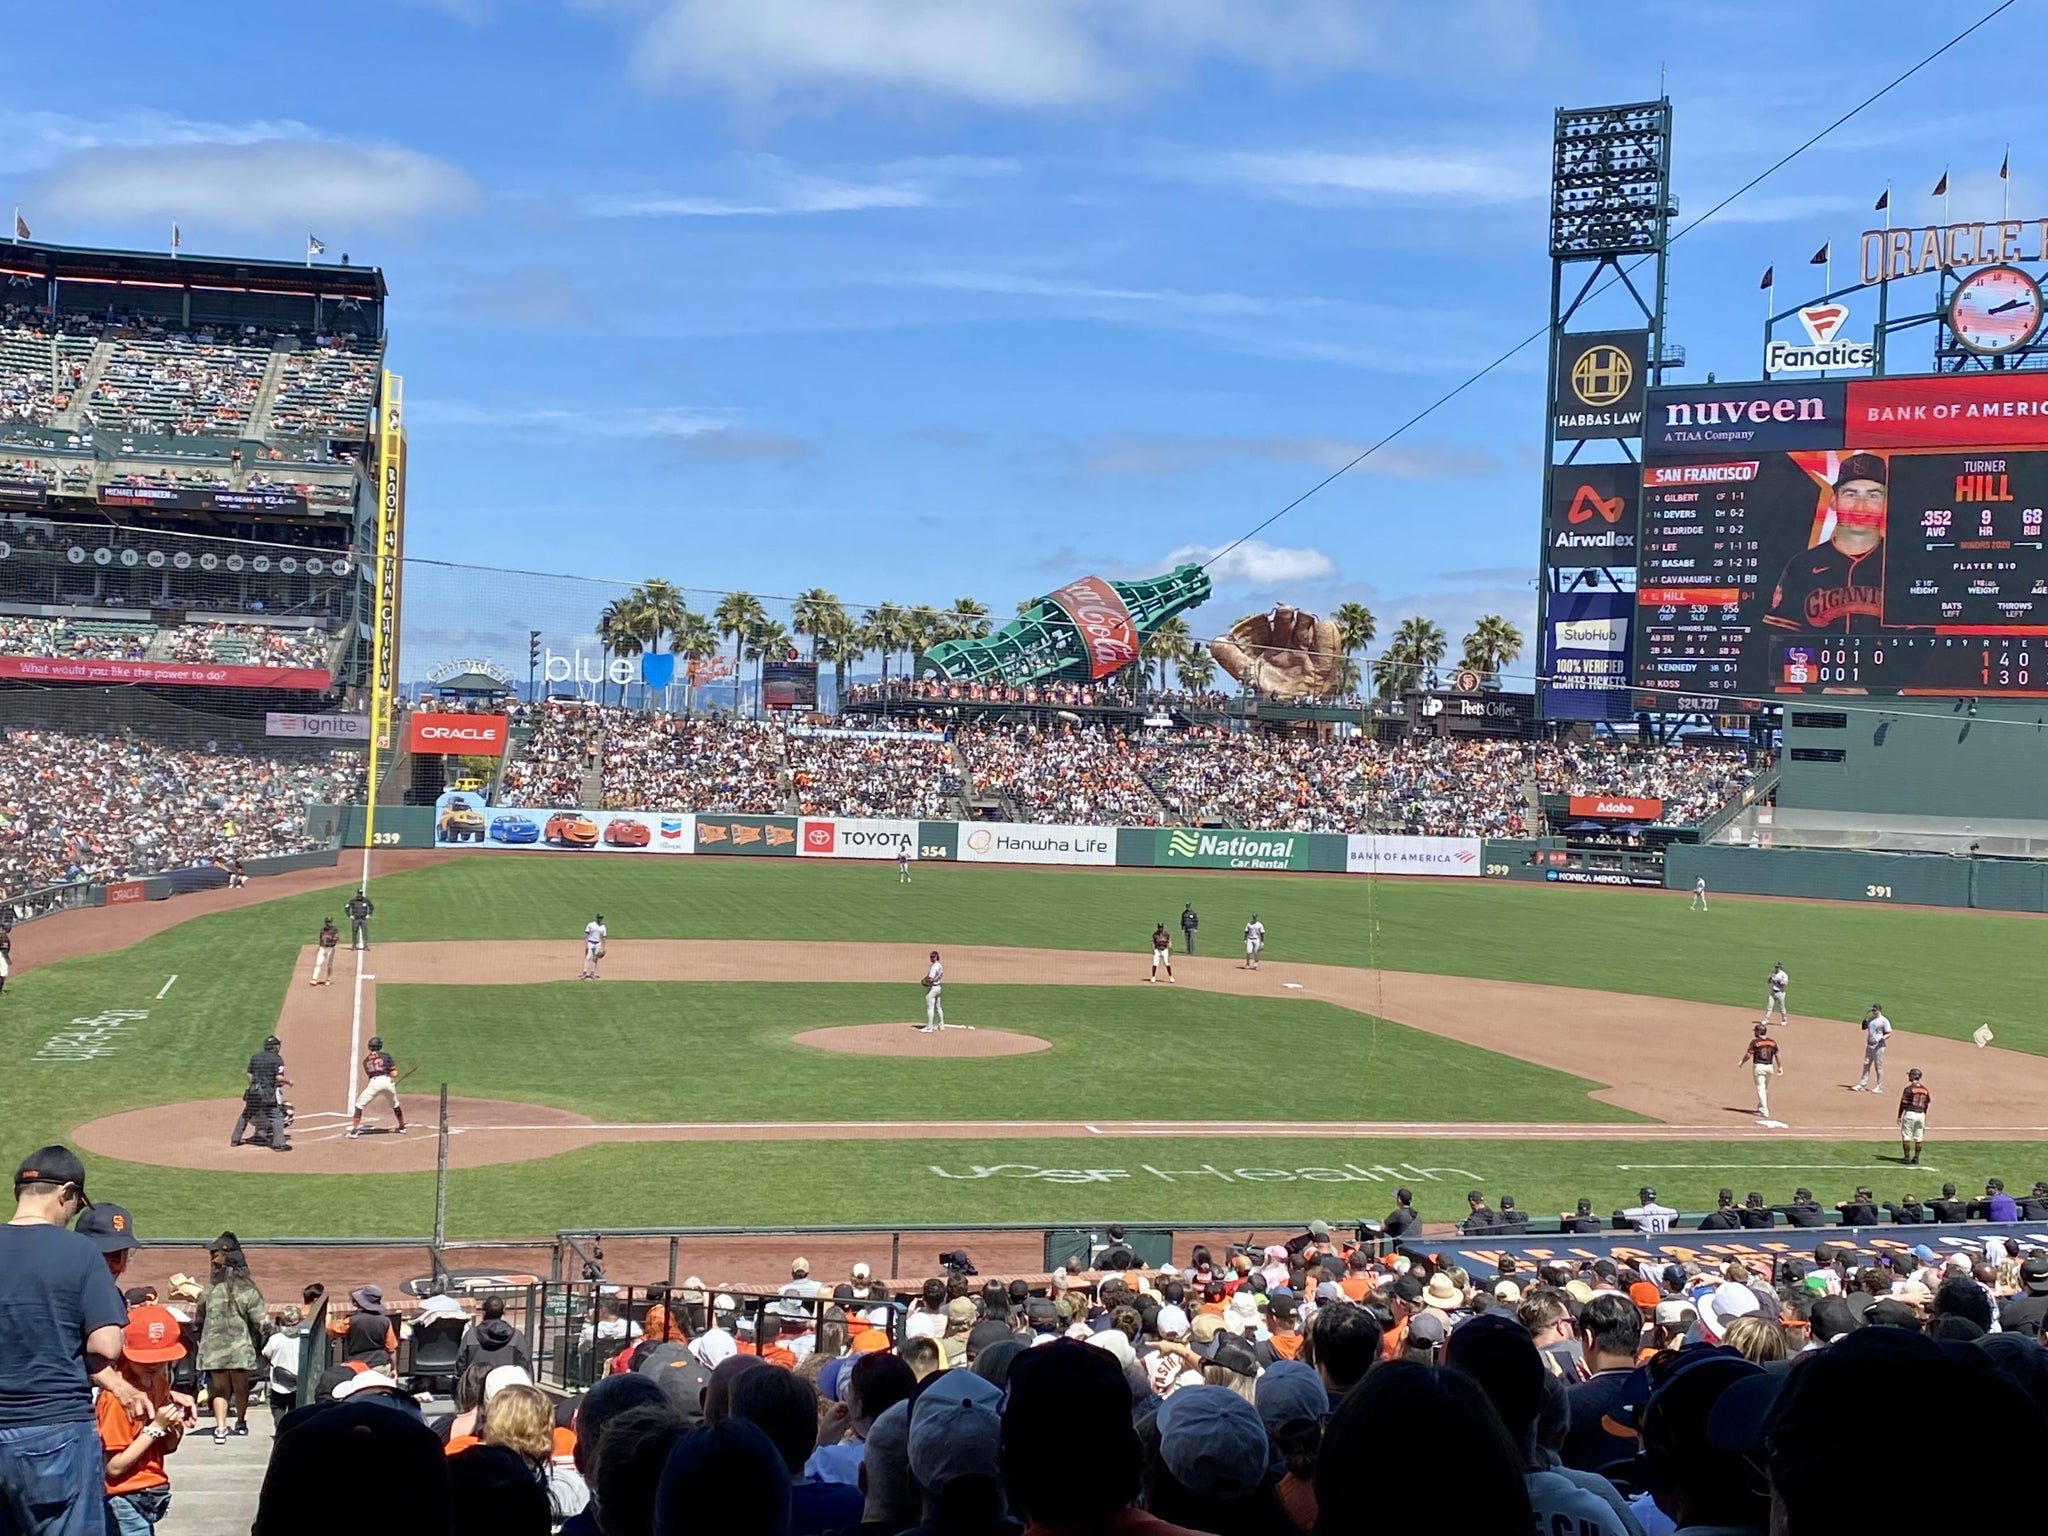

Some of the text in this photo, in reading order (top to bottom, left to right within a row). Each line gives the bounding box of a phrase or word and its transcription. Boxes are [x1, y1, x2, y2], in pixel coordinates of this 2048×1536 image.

[1860, 220, 2022, 286] ORACLE
[1993, 273, 2001, 281] 12
[1770, 343, 1873, 367] Fanatics
[1665, 396, 1825, 427] nuveen
[1867, 406, 1926, 421] BANK
[1933, 404, 1961, 419] OF
[1559, 412, 1641, 427] HABBAS LAW
[1664, 431, 1755, 442] A TIAA Company
[1964, 460, 2006, 473] TURNER
[1656, 467, 1751, 482] SAN FRANCISCO
[105, 488, 134, 496] MICHAEL
[135, 490, 171, 498] LORENZEN
[1956, 475, 2014, 502] HILL
[215, 495, 252, 503] FOUR-SEAM
[264, 496, 284, 504] 92.4
[1664, 493, 1699, 502] GILBERT
[1731, 492, 1744, 500] 1-1
[1664, 510, 1696, 518] DEVERS
[1730, 509, 1744, 517] 0-2
[1921, 510, 1952, 526] .352
[1981, 510, 1992, 525] 9
[2022, 509, 2043, 524] 68
[1663, 526, 1704, 534] ELDRIDGE
[1729, 525, 1744, 534] 0-2
[1926, 527, 1945, 537] AVG
[1979, 527, 1993, 536] HR
[2023, 526, 2040, 536] RBI
[1555, 531, 1634, 547] Airwallex
[1662, 542, 1758, 551] LEE 1-1 1B
[73, 551, 79, 559] 3
[99, 552, 105, 560] 4
[229, 559, 241, 567] 25
[255, 560, 268, 568] 27
[283, 561, 294, 569] 30
[1661, 558, 1757, 567] BASABE 1-2 1B
[380, 467, 396, 689] ROOT 4 THA CHIKIN
[1661, 574, 1757, 584] CAVANAUGH 0-1 BB
[1663, 592, 1755, 600] HILL 0-1
[1658, 605, 1739, 613] .426 .530 .956
[1941, 602, 1962, 610] BATS
[1997, 602, 2032, 610] THROWS
[1565, 629, 1617, 641] StubHub
[1821, 650, 2029, 667] 0 0 1 0 1 4 0
[20, 663, 227, 681] What would you like the power to do?
[545, 647, 635, 685] blue
[1556, 659, 1624, 674] 100% VERIFIED
[1657, 664, 1737, 672] KENNEDY 0-1
[1820, 667, 2028, 685] 0 0 1 1 3 0
[1553, 675, 1626, 690] GIANTS TICKETS
[1657, 680, 1680, 688] KOSS
[1724, 681, 1737, 689] 0-1
[1678, 697, 1720, 710] $24,737
[1486, 702, 1516, 718] Coffee
[302, 716, 357, 734] ignite
[421, 727, 496, 740] ORACLE
[1596, 802, 1635, 814] Adobe
[373, 833, 400, 844] 339
[842, 832, 912, 846] TOYOTA
[997, 836, 1107, 853] Hanwha Life
[921, 846, 947, 857] 354
[1198, 835, 1294, 858] National
[1350, 851, 1451, 863] BANK OF AMERICA
[1230, 858, 1288, 869] Car Rental
[1486, 864, 1509, 876] 399
[1558, 872, 1592, 883] KONICA
[1593, 874, 1632, 885] MINOLTA
[112, 889, 140, 901] ORACLE
[1866, 885, 1892, 898] 391
[928, 1162, 1486, 1184] UCSF Health
[113, 1215, 125, 1232] SF
[1652, 1218, 1665, 1232] 81
